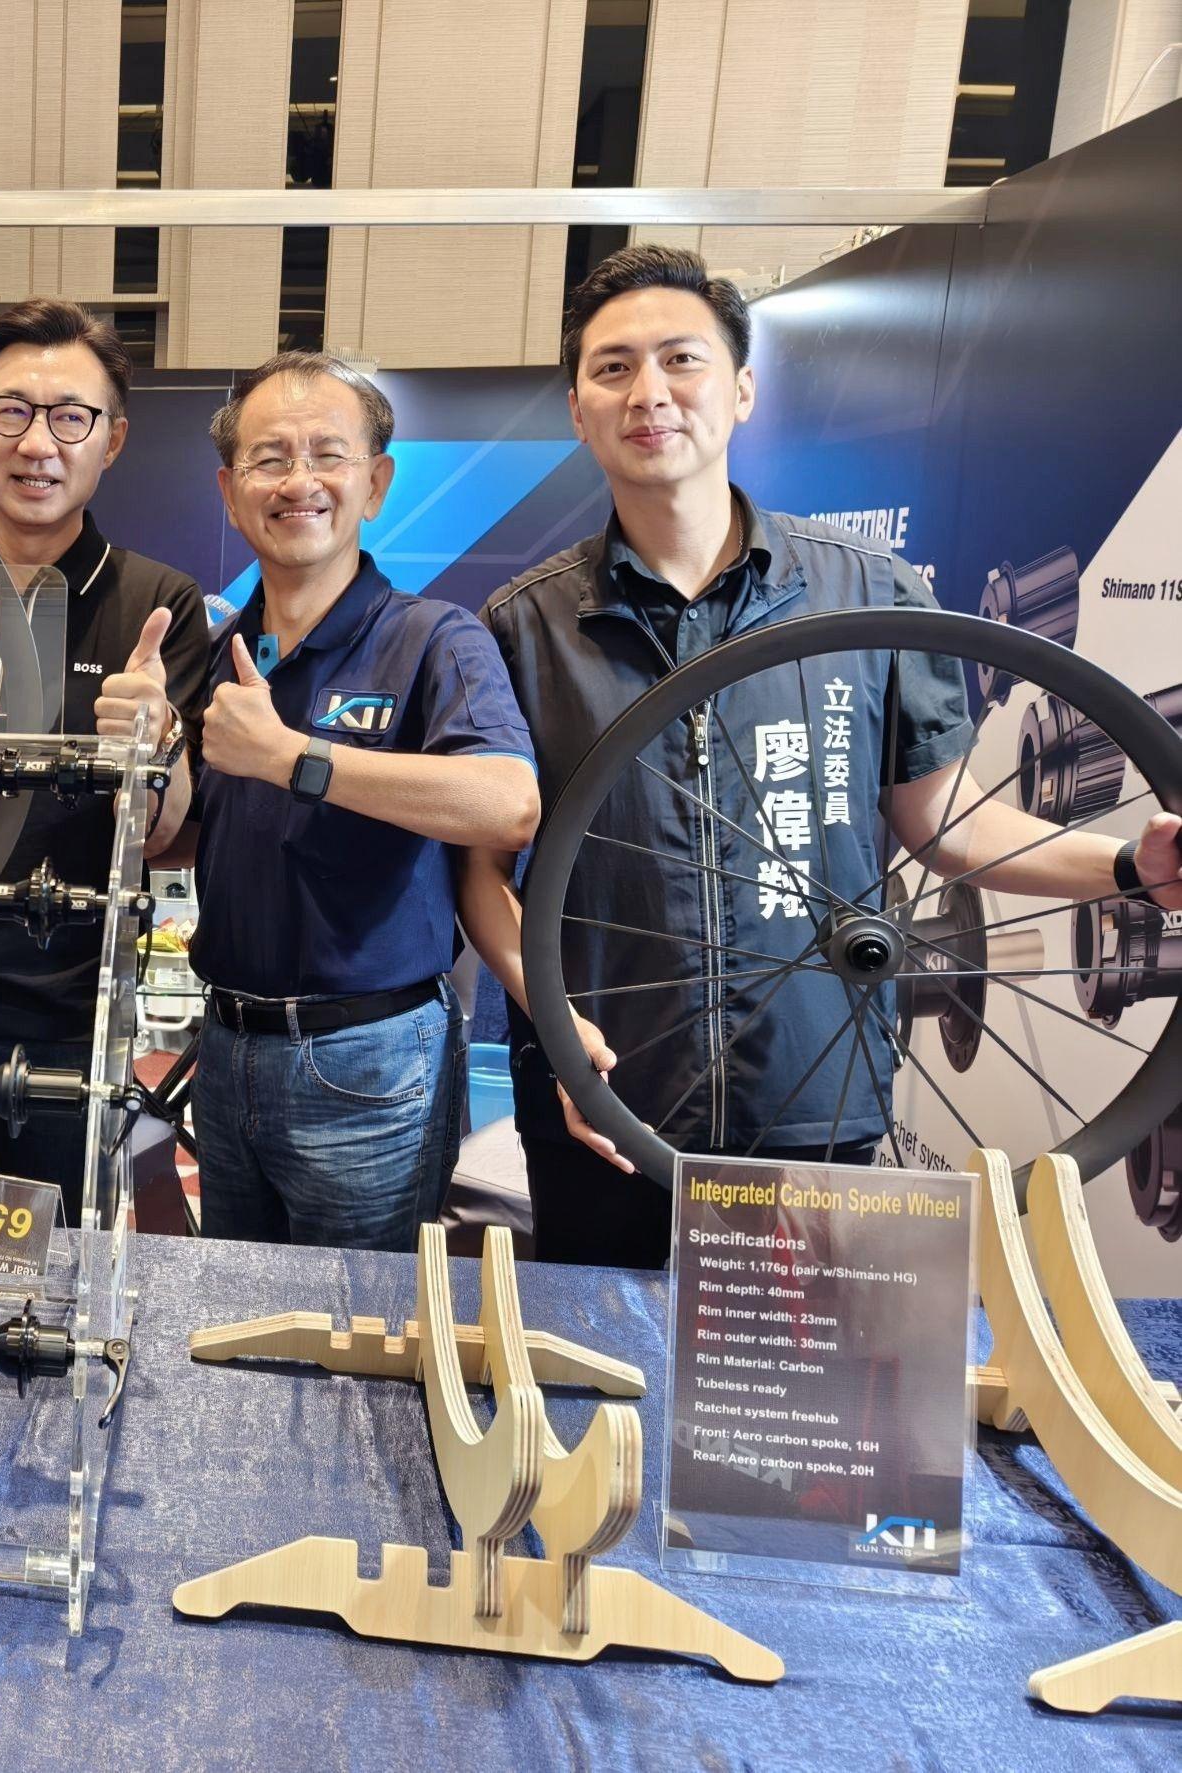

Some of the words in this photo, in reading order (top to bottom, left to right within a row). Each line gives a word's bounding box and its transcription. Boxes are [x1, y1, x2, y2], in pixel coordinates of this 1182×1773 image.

[1101, 577, 1155, 600] Shimano
[73, 663, 103, 674] BOSS
[823, 677, 854, 826] 立法委員
[753, 719, 812, 919] 廖偉翔
[690, 1176, 775, 1207] Integrated
[780, 1183, 842, 1210] Carbon
[848, 1187, 901, 1216] Spoke
[907, 1192, 960, 1219] Wheel
[688, 1229, 807, 1251] Specifications
[699, 1256, 746, 1271] Weight:
[749, 1261, 788, 1276] 1,176g
[791, 1264, 819, 1279] (pair
[822, 1266, 890, 1282] w/Shimano
[893, 1271, 917, 1286] HG)
[699, 1281, 723, 1294] Rim
[726, 1283, 765, 1298] depth:
[767, 1287, 805, 1300] 40mm
[698, 1305, 722, 1317] Rim
[725, 1307, 757, 1319] inner
[759, 1309, 797, 1323] width:
[800, 1313, 837, 1327] 23mm
[697, 1329, 722, 1341] Rim
[724, 1332, 757, 1344] outer
[759, 1333, 797, 1348] width:
[800, 1338, 837, 1351] 30mm
[696, 1353, 720, 1365] Rim
[723, 1355, 776, 1371] Material:
[779, 1360, 824, 1375] Carbon
[695, 1376, 749, 1392] Tubeless
[753, 1383, 787, 1397] ready
[695, 1401, 741, 1416] Ratchet
[744, 1407, 789, 1423] system
[791, 1409, 839, 1425] freehub
[694, 1425, 730, 1440] Front:
[733, 1430, 762, 1442] Aero
[765, 1432, 808, 1446] carbon
[811, 1437, 852, 1452] spoke,
[856, 1440, 880, 1453] 16H
[693, 1449, 725, 1464] Rear:
[727, 1453, 757, 1466] Aero
[760, 1456, 803, 1471] carbon
[806, 1460, 847, 1475] spoke,
[850, 1464, 875, 1477] 20H
[855, 1544, 878, 1553] KUN
[883, 1547, 912, 1557] TENG
